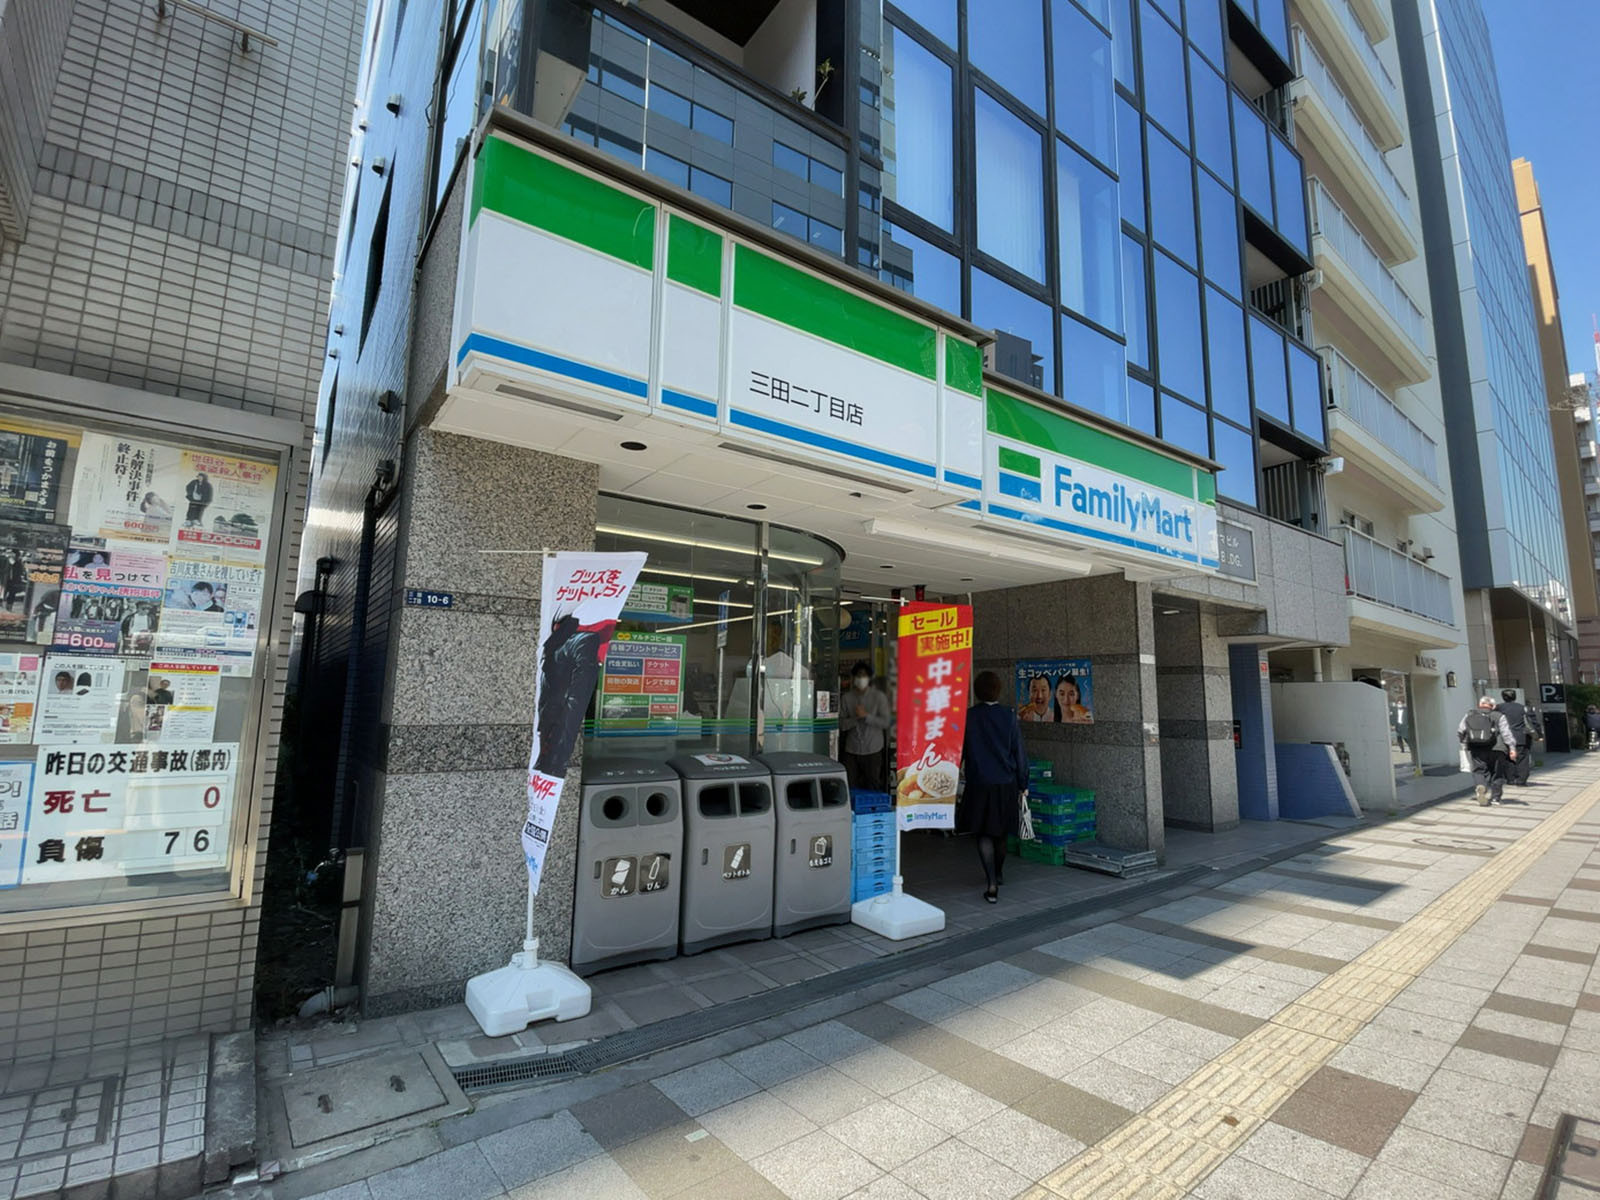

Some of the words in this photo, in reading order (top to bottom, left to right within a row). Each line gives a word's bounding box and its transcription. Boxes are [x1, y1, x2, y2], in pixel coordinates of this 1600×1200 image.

[749, 370, 864, 427] 三田二丁目店
[1054, 463, 1193, 544] FamilyMart
[427, 594, 450, 605] 10-6
[911, 611, 954, 631] セール
[919, 629, 970, 654] 実施中!
[1541, 685, 1557, 702] P
[916, 656, 952, 772] 中華まん
[43, 789, 111, 815] 死亡
[203, 786, 221, 809] 0
[36, 837, 105, 865] 負傷
[610, 886, 629, 896] かん
